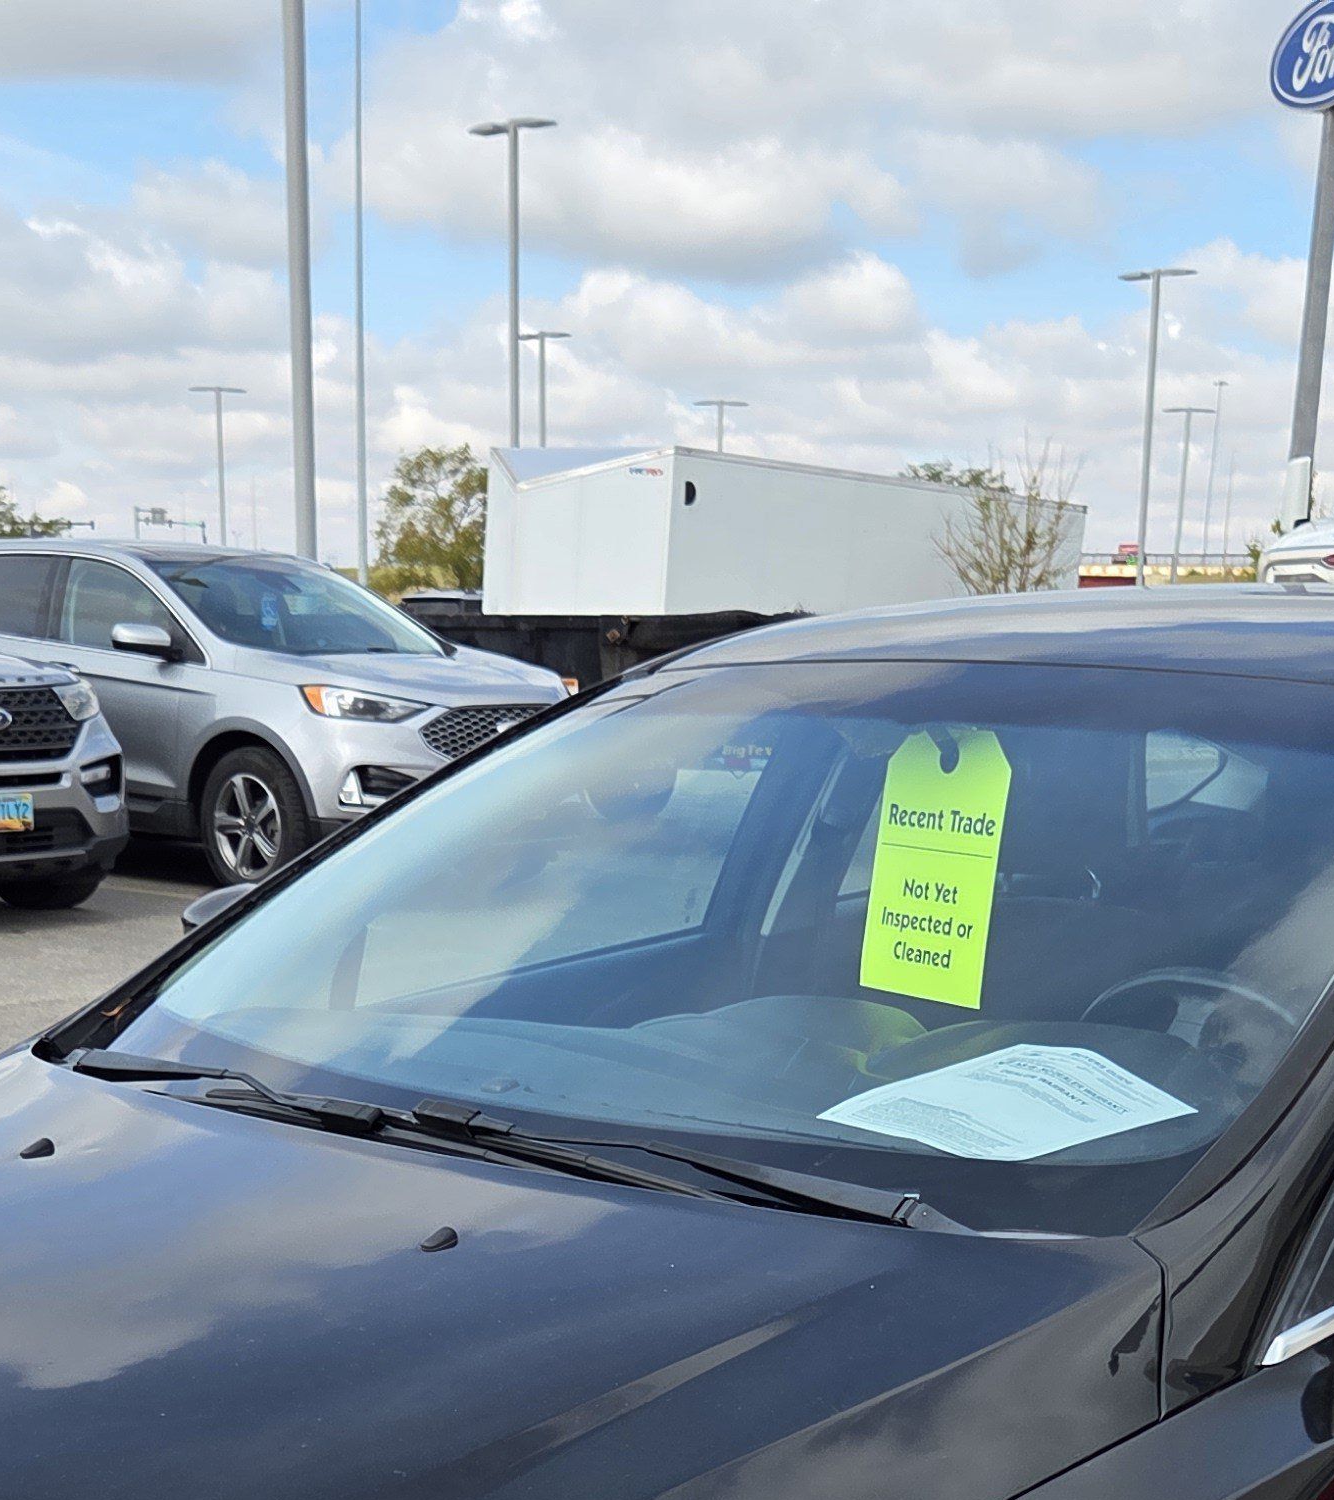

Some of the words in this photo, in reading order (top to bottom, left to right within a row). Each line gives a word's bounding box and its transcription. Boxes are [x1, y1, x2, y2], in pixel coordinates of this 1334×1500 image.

[888, 803, 944, 831] Recent
[951, 809, 996, 836] Trade
[903, 878, 929, 900] Not
[935, 882, 958, 905] Yet
[881, 906, 953, 936] Inspected
[956, 923, 974, 939] or
[893, 940, 952, 969] Cleaned
